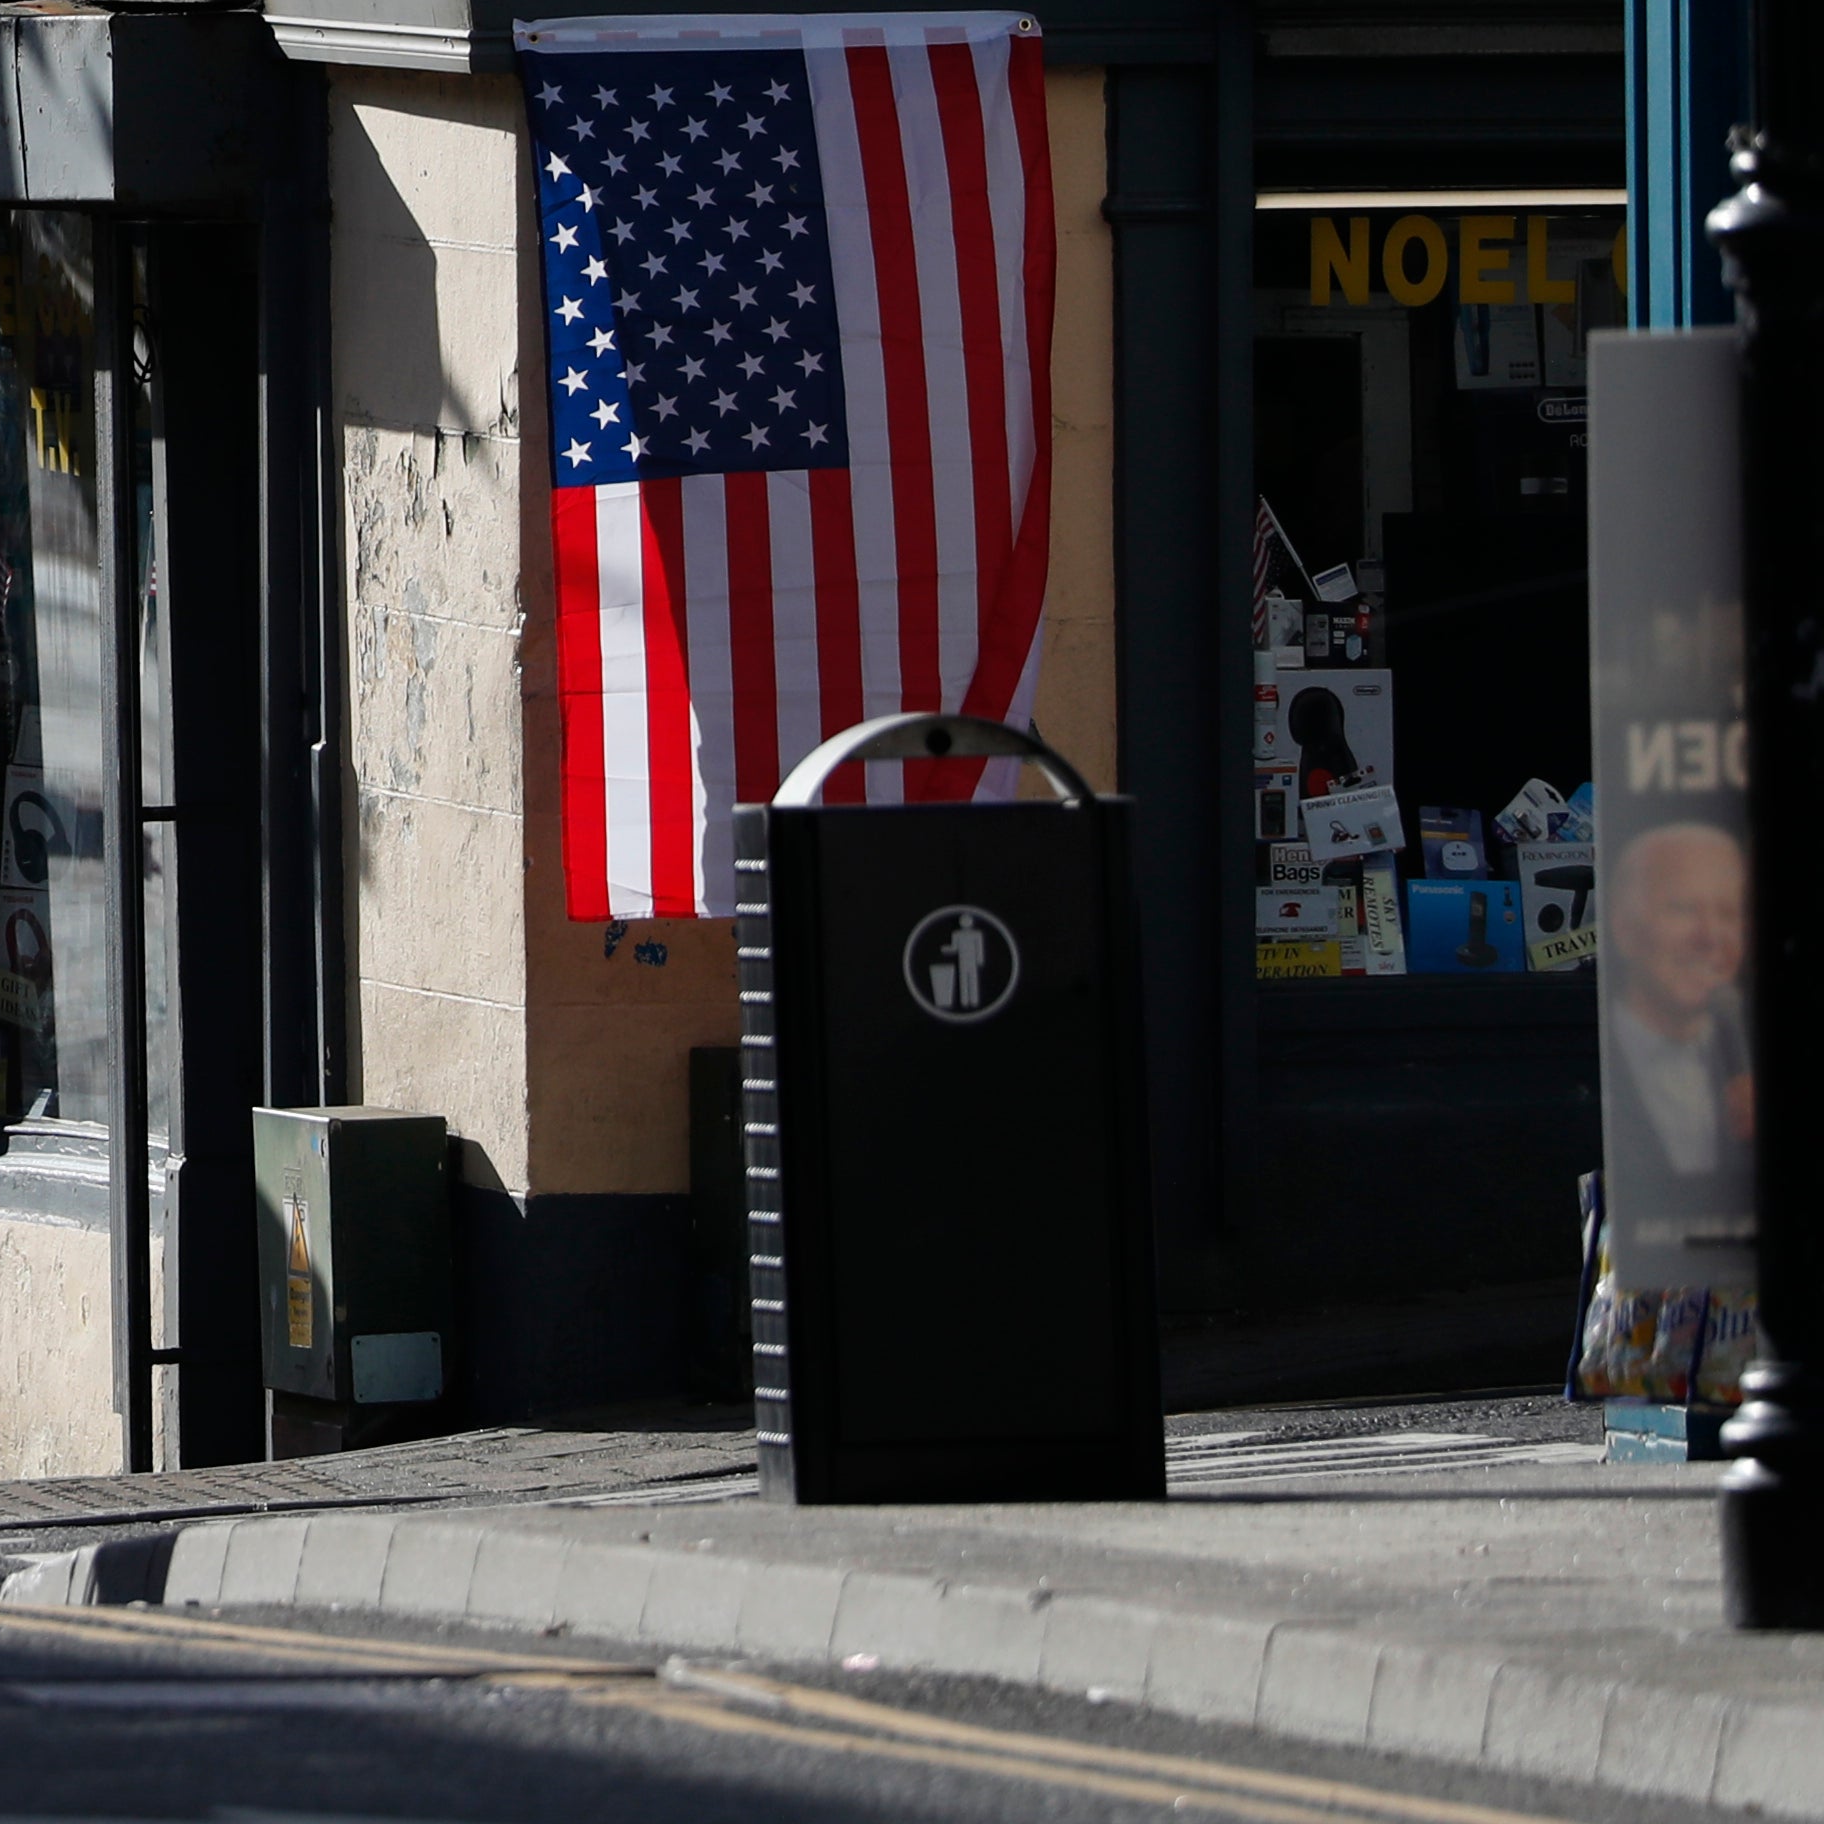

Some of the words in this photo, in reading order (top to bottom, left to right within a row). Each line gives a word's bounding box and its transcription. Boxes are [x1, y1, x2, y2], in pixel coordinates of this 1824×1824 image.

[1308, 213, 1579, 308] NOEL
[1305, 798, 1337, 812] SPRING
[1272, 863, 1321, 884] Bags
[1412, 884, 1465, 895] Panasonic
[1363, 875, 1385, 949] REMOTES
[1284, 946, 1301, 960] IN
